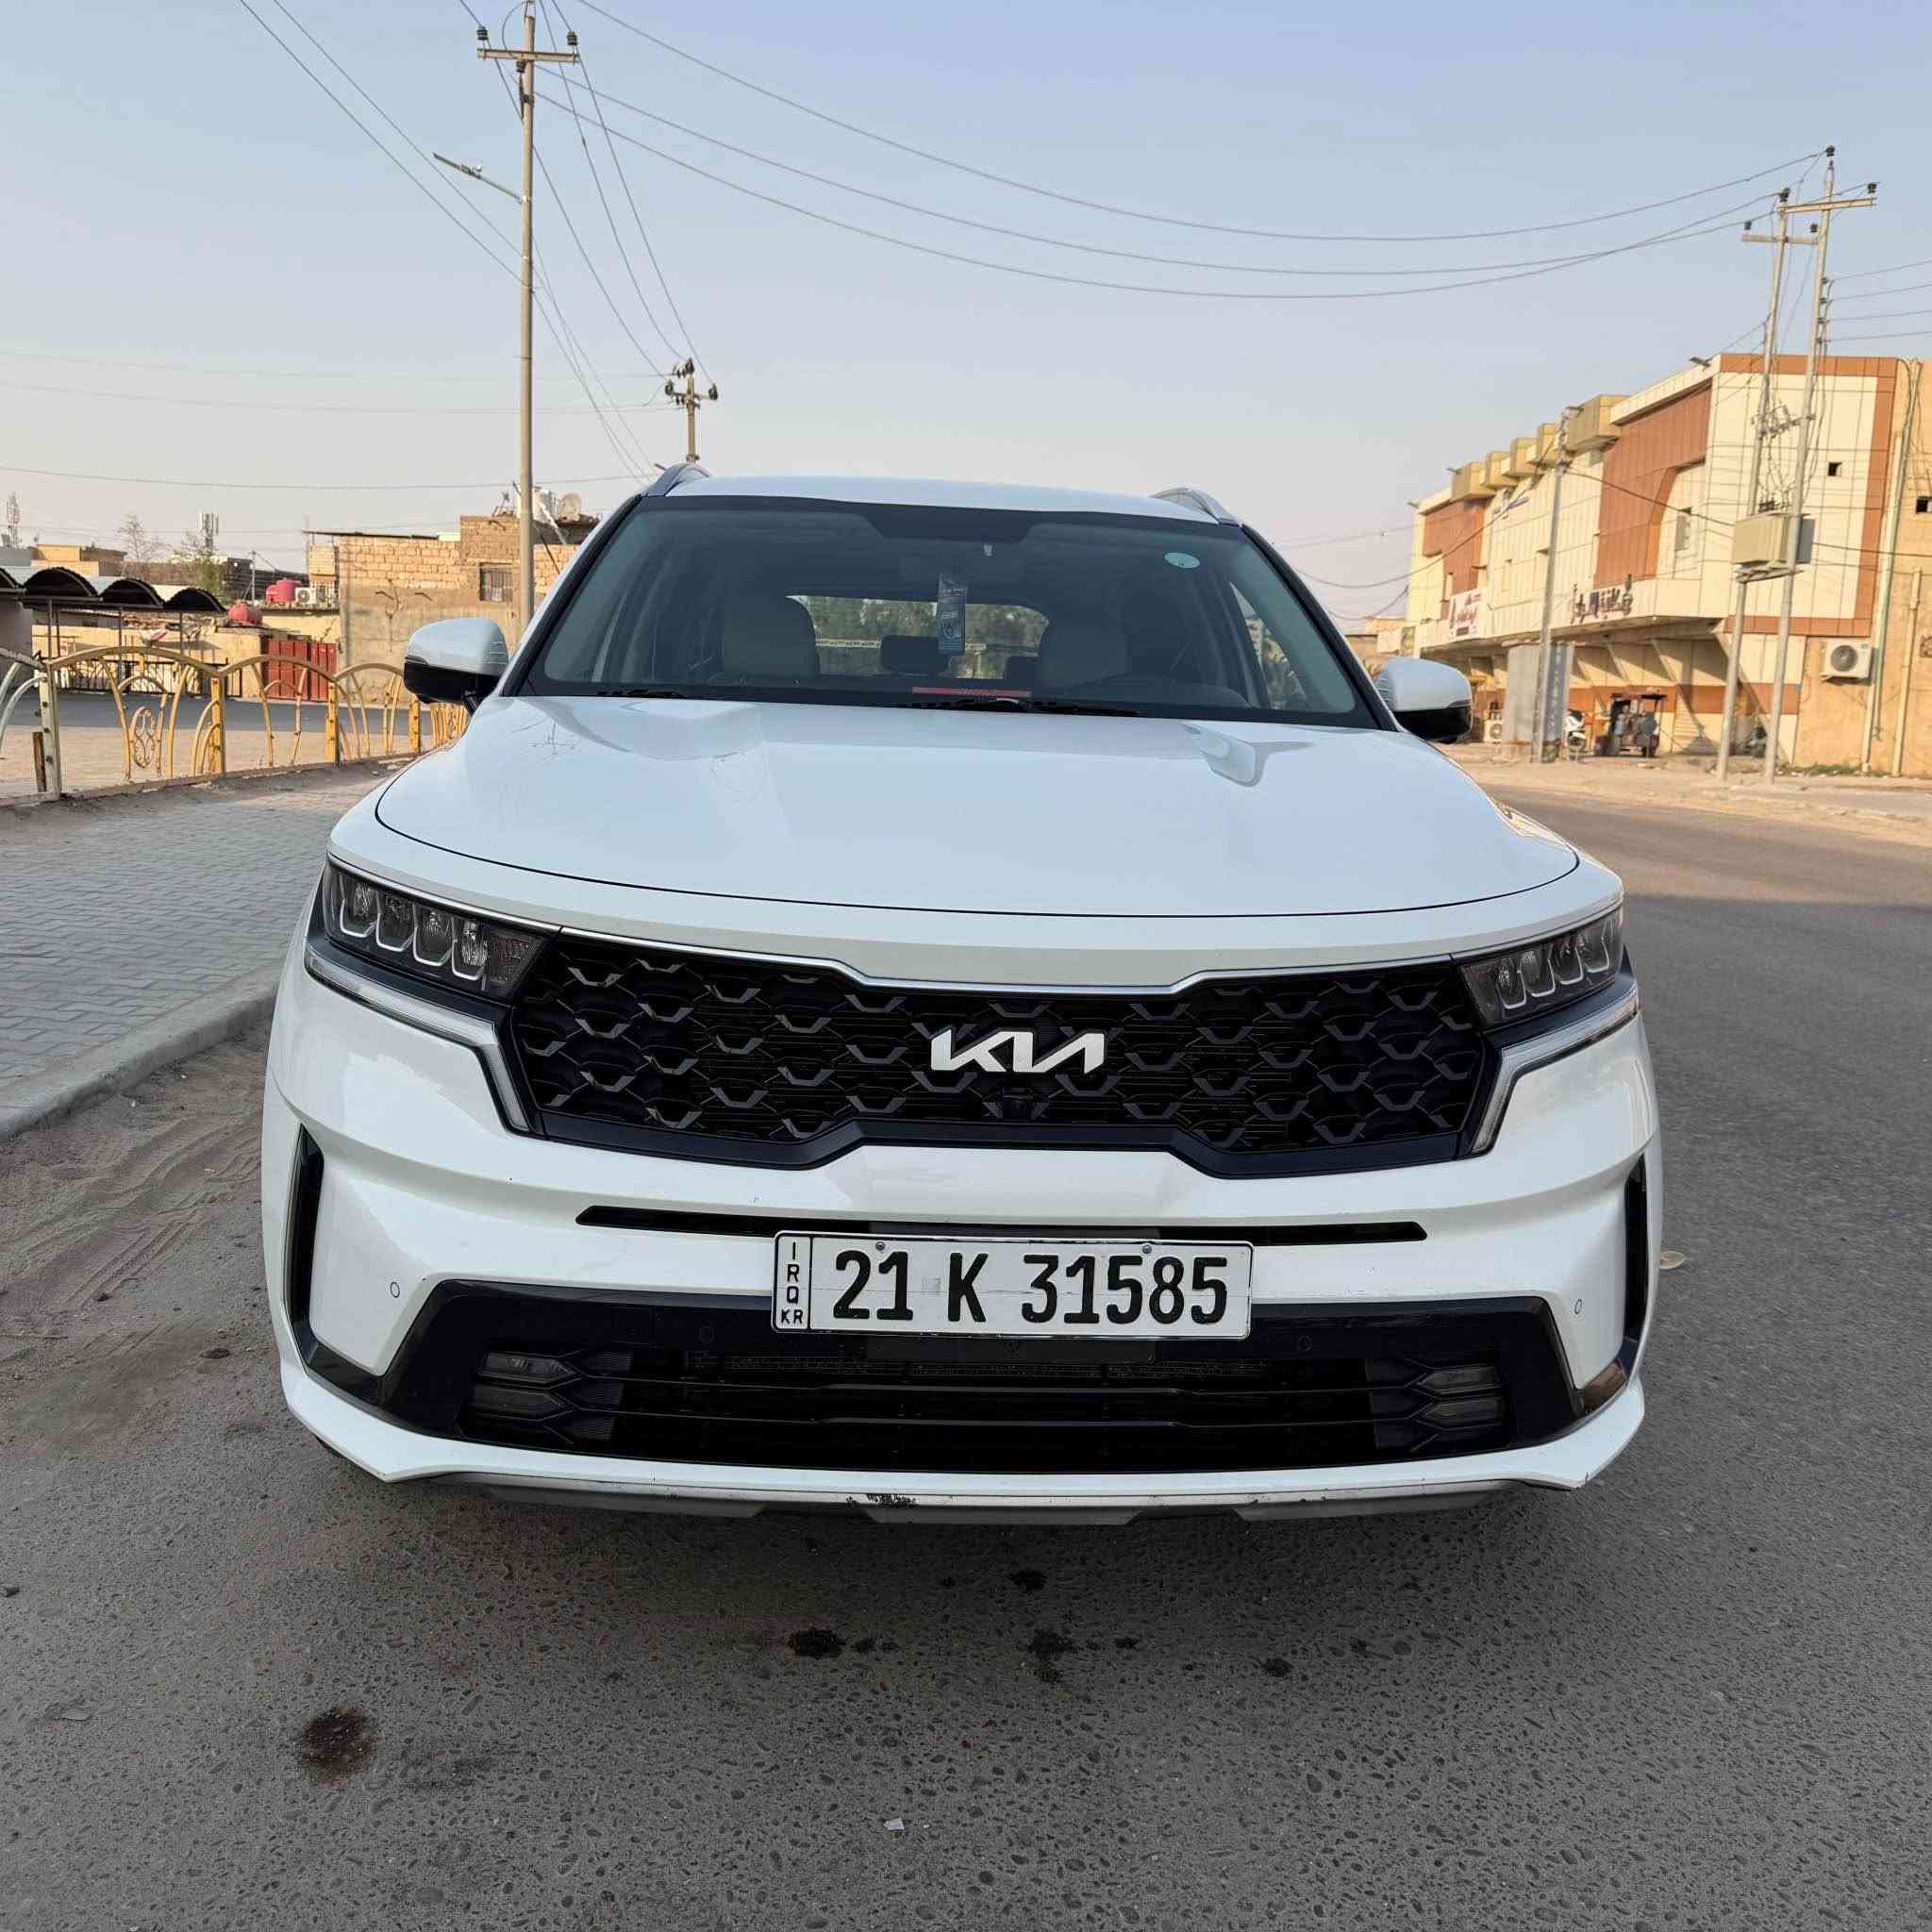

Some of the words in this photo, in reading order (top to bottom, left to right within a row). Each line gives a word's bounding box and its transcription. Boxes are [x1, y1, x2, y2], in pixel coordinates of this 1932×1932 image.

[787, 1241, 800, 1304] IRQ
[833, 1250, 913, 1321] 21
[947, 1252, 989, 1322] K
[1021, 1255, 1228, 1324] 31585
[781, 1308, 804, 1324] KR
